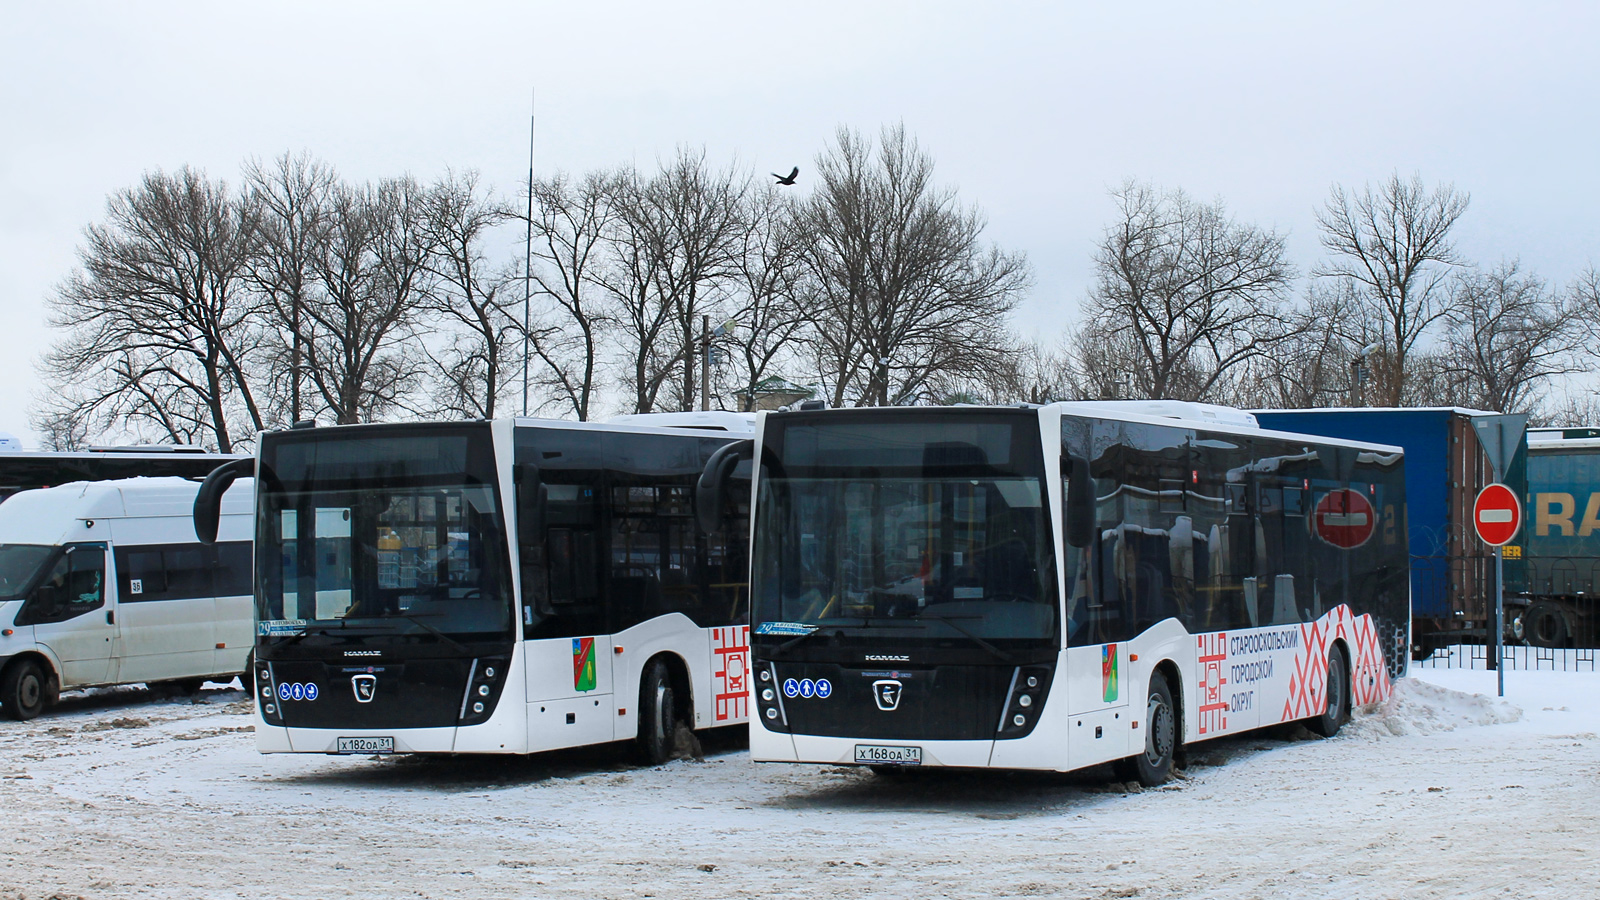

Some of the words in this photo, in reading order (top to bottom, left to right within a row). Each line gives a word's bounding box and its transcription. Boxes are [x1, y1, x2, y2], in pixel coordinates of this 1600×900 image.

[1526, 492, 1600, 536] RA
[259, 622, 270, 636] 29
[1231, 626, 1298, 656] СТАРООСКОЛЬСКИЙ
[1231, 655, 1273, 685] ГОРОДСКОЙ
[1231, 691, 1253, 713] ОКРУГ
[380, 738, 390, 747] 31
[905, 748, 917, 758] 31
